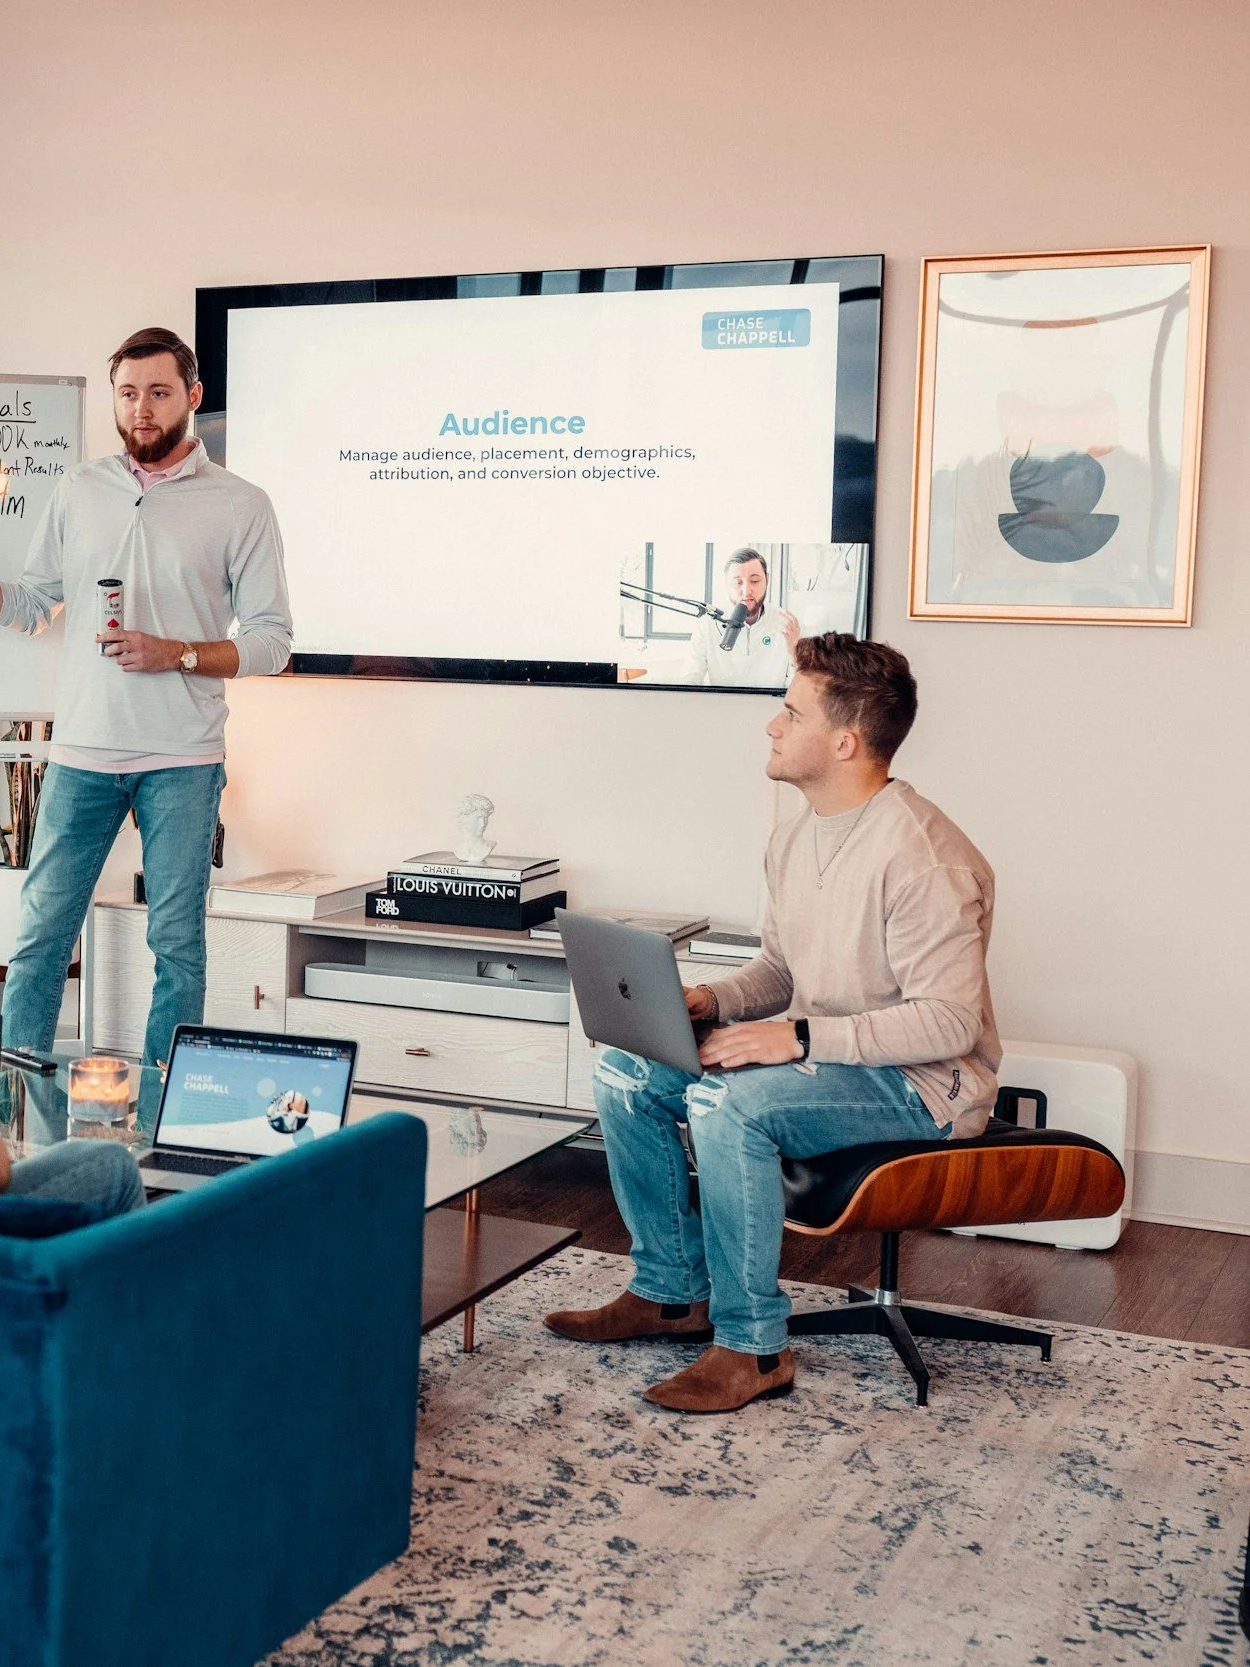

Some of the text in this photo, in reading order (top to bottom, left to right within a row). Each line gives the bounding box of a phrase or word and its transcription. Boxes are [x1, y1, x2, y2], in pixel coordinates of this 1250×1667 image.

[717, 317, 764, 330] CHASE
[717, 330, 796, 345] CHAPPELL
[438, 409, 586, 436] Audience
[339, 444, 696, 464] Manage audience, placement, demographics,
[24, 456, 64, 476] Results
[369, 463, 660, 482] attribution, and conversion objective.
[422, 865, 462, 876] CHANEL
[397, 877, 438, 894] LOUIS
[441, 881, 506, 900] VUITTON
[375, 898, 396, 908] TOM
[376, 905, 400, 915] FORD
[185, 1072, 214, 1084] CHASE
[183, 1081, 230, 1095] CHAPPELL
